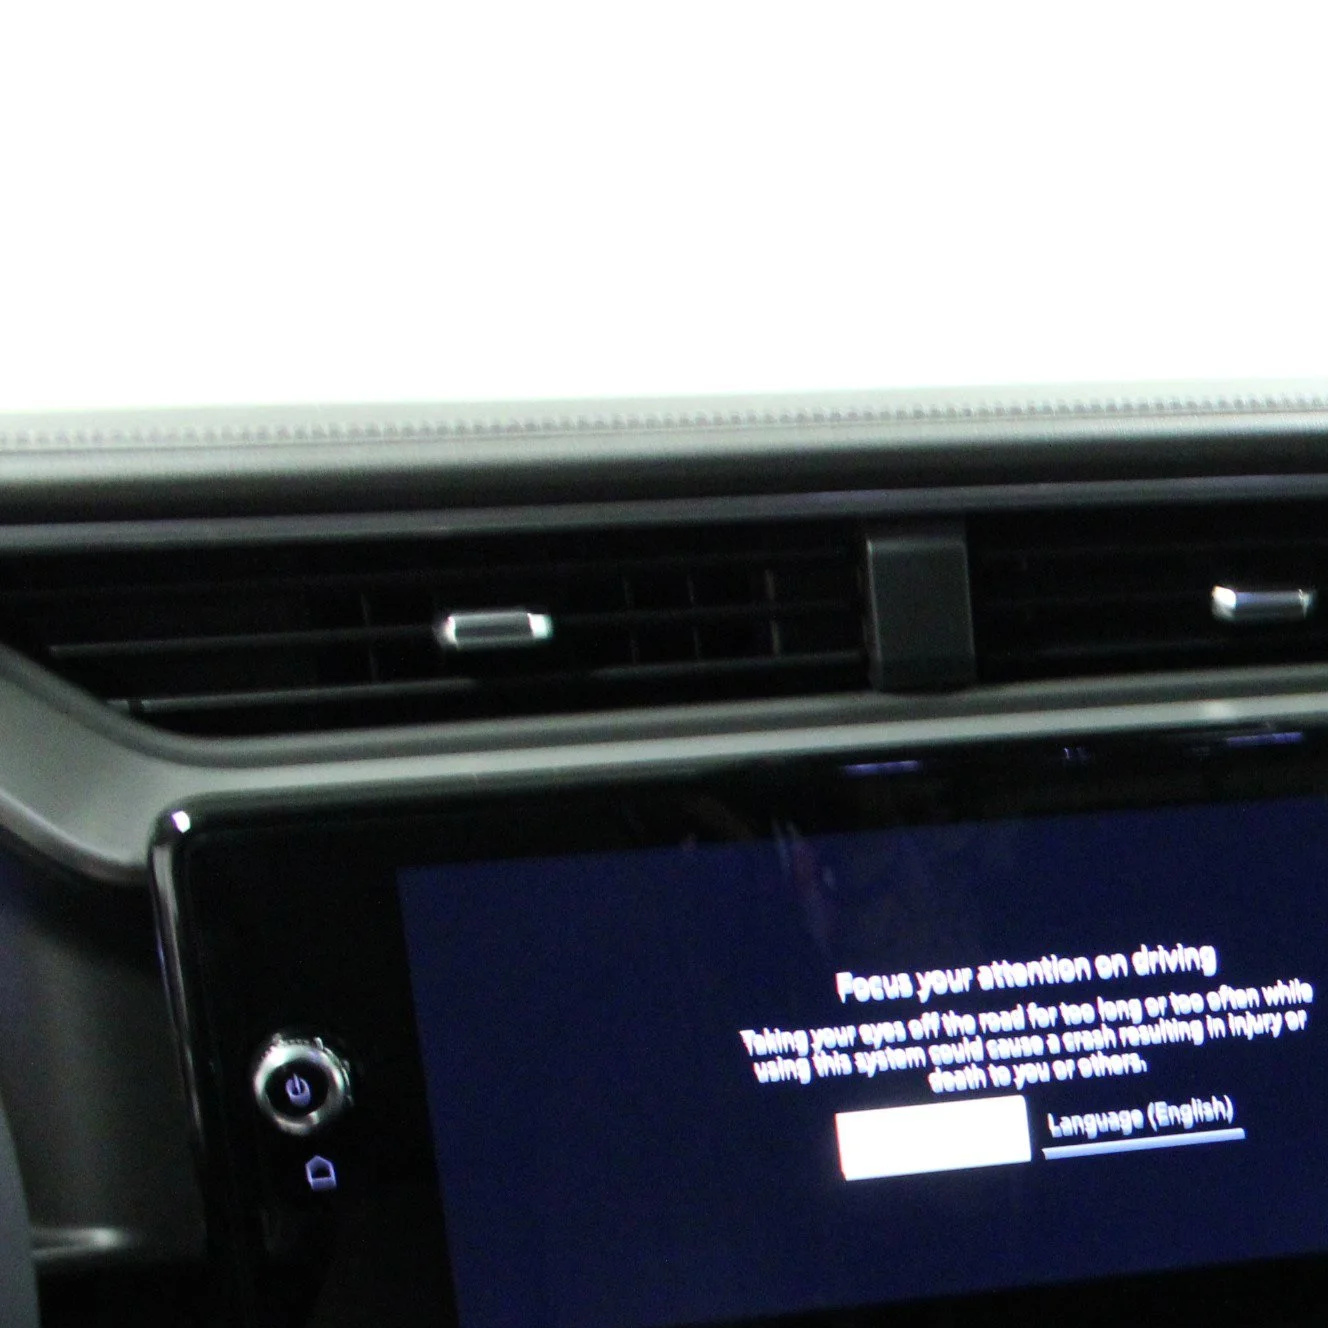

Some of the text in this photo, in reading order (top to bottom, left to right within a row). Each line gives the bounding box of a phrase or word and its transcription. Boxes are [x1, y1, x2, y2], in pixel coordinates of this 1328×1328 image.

[836, 943, 1217, 1003] Focus your attention on driving
[739, 978, 1313, 1057] Taking your eyes off the road for too long or too often while
[754, 1009, 1307, 1084] using this system could cause a crash resulting in injury or
[928, 1051, 1147, 1093] death to you or others.
[1048, 1095, 1234, 1139] Language (English)
